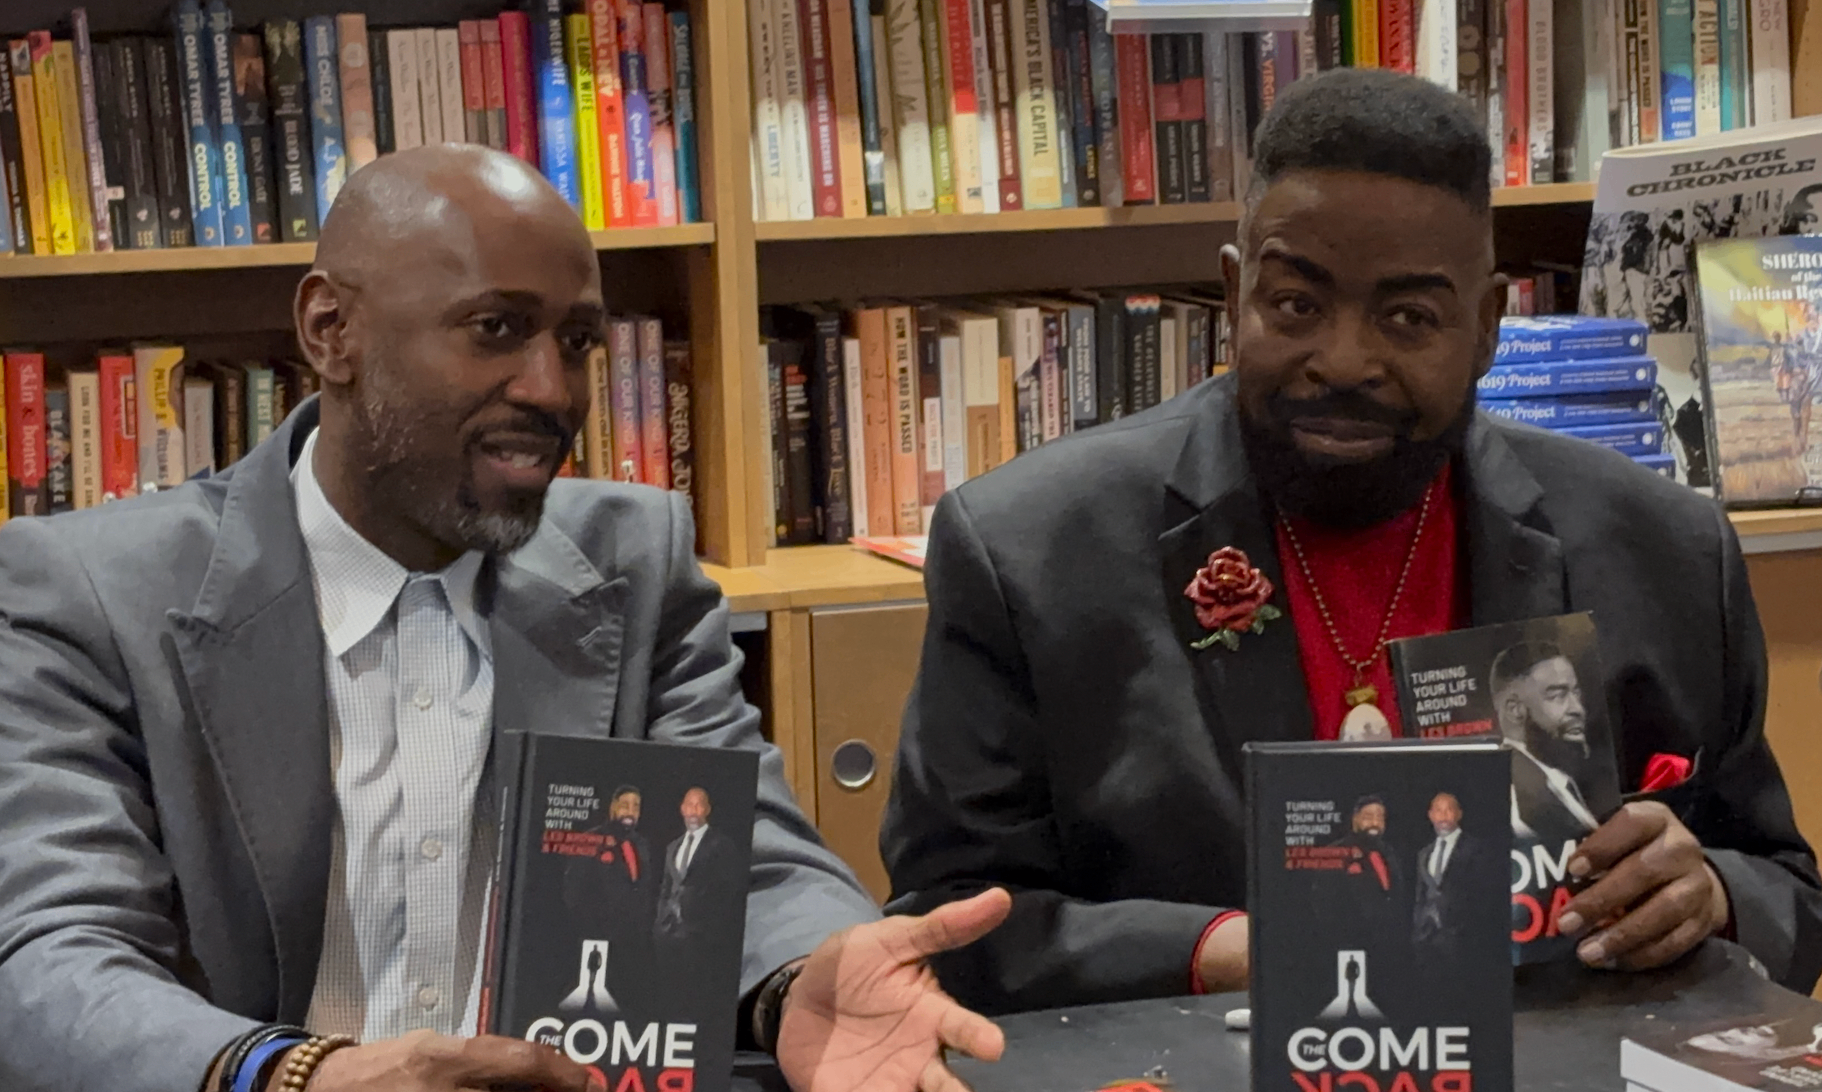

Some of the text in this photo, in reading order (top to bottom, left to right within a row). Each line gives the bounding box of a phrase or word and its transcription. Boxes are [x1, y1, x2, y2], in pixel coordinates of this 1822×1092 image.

[1759, 0, 1773, 31] GRO
[1698, 11, 1719, 65] ACTION
[184, 35, 205, 127] OMAR TYREE
[213, 34, 235, 125] OMAR TYREE
[317, 60, 335, 106] CHLOE
[784, 69, 801, 97] MAN
[1025, 0, 1049, 157] MERICA'S BLACK CAPITAL
[1262, 59, 1277, 111] VIRGIN
[1536, 21, 1548, 131] BLOOD BROTHERS
[224, 141, 241, 210] CONTROL
[1669, 148, 1786, 177] BLACK
[194, 143, 212, 212] CONTROL
[285, 163, 303, 196] JADE
[1626, 158, 1817, 198] CHRONICLE
[1790, 270, 1822, 282] of the
[1729, 285, 1793, 302] Haitian
[618, 323, 632, 353] ONE
[646, 321, 660, 350] ONE
[1510, 338, 1552, 355] Project
[620, 356, 633, 374] OF
[647, 355, 661, 373] OF
[825, 338, 840, 374] Black
[21, 363, 38, 403] skin
[621, 378, 635, 408] OUR
[650, 377, 663, 406] OUR
[896, 317, 913, 454] HOW THE WORD IS PASSED
[1507, 373, 1552, 389] Project
[1084, 400, 1092, 413] TO
[1513, 405, 1556, 422] Project
[22, 424, 40, 478] bones
[829, 428, 843, 463] Black
[1411, 665, 1467, 685] TURNING
[1413, 678, 1477, 698] YOUR LIFE
[1416, 694, 1467, 713] AROUND
[1418, 711, 1451, 727] WITH
[547, 795, 600, 810] YOUR LIFE
[548, 783, 595, 797] TURNING
[545, 807, 589, 820] AROUND
[1285, 801, 1335, 812] TURNING
[1285, 812, 1342, 823] YOUR LIFE
[545, 818, 573, 830] WITH
[1285, 824, 1331, 835] AROUND
[1285, 836, 1315, 846] WITH
[1511, 839, 1580, 893] OM
[525, 1016, 697, 1068] COME
[540, 1034, 562, 1046] THE
[1287, 1027, 1472, 1071] COME
[1302, 1044, 1327, 1056] THE
